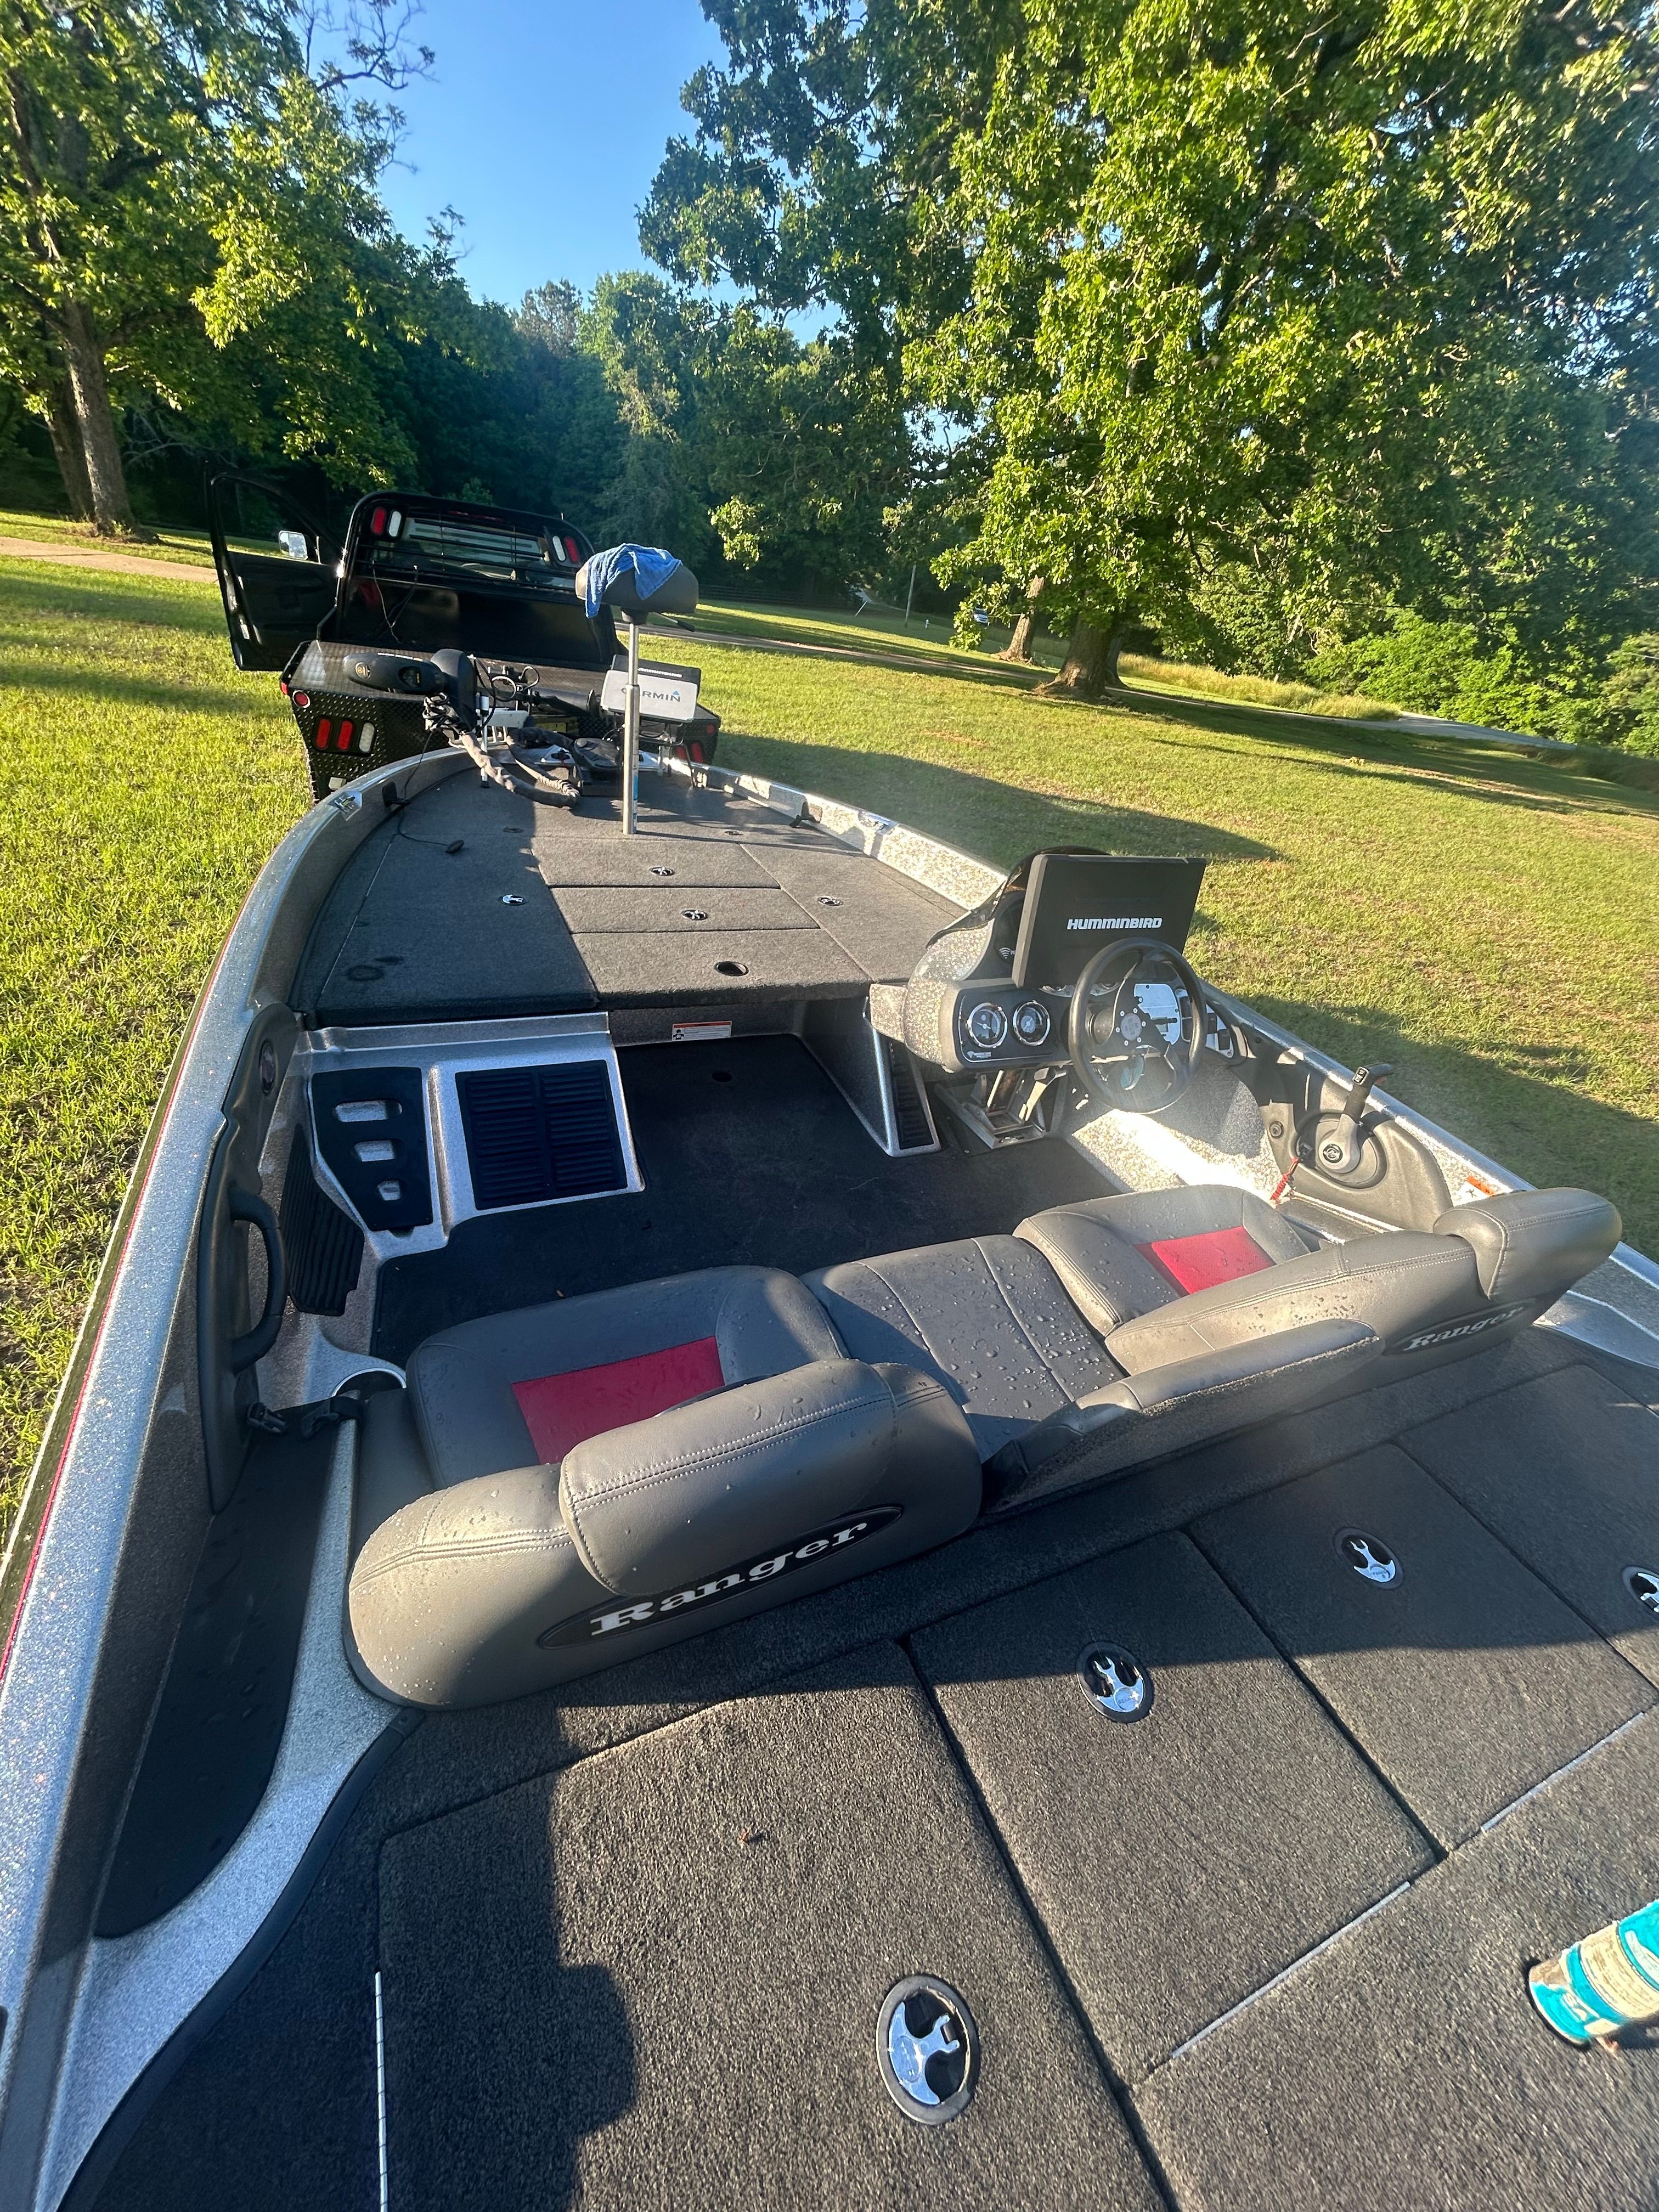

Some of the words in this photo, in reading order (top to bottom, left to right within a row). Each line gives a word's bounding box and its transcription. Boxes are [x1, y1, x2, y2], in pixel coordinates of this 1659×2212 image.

[1067, 918, 1163, 930] HUMMINBIRD
[1403, 1306, 1524, 1351] Ranger
[590, 1522, 867, 1636] Ranger
